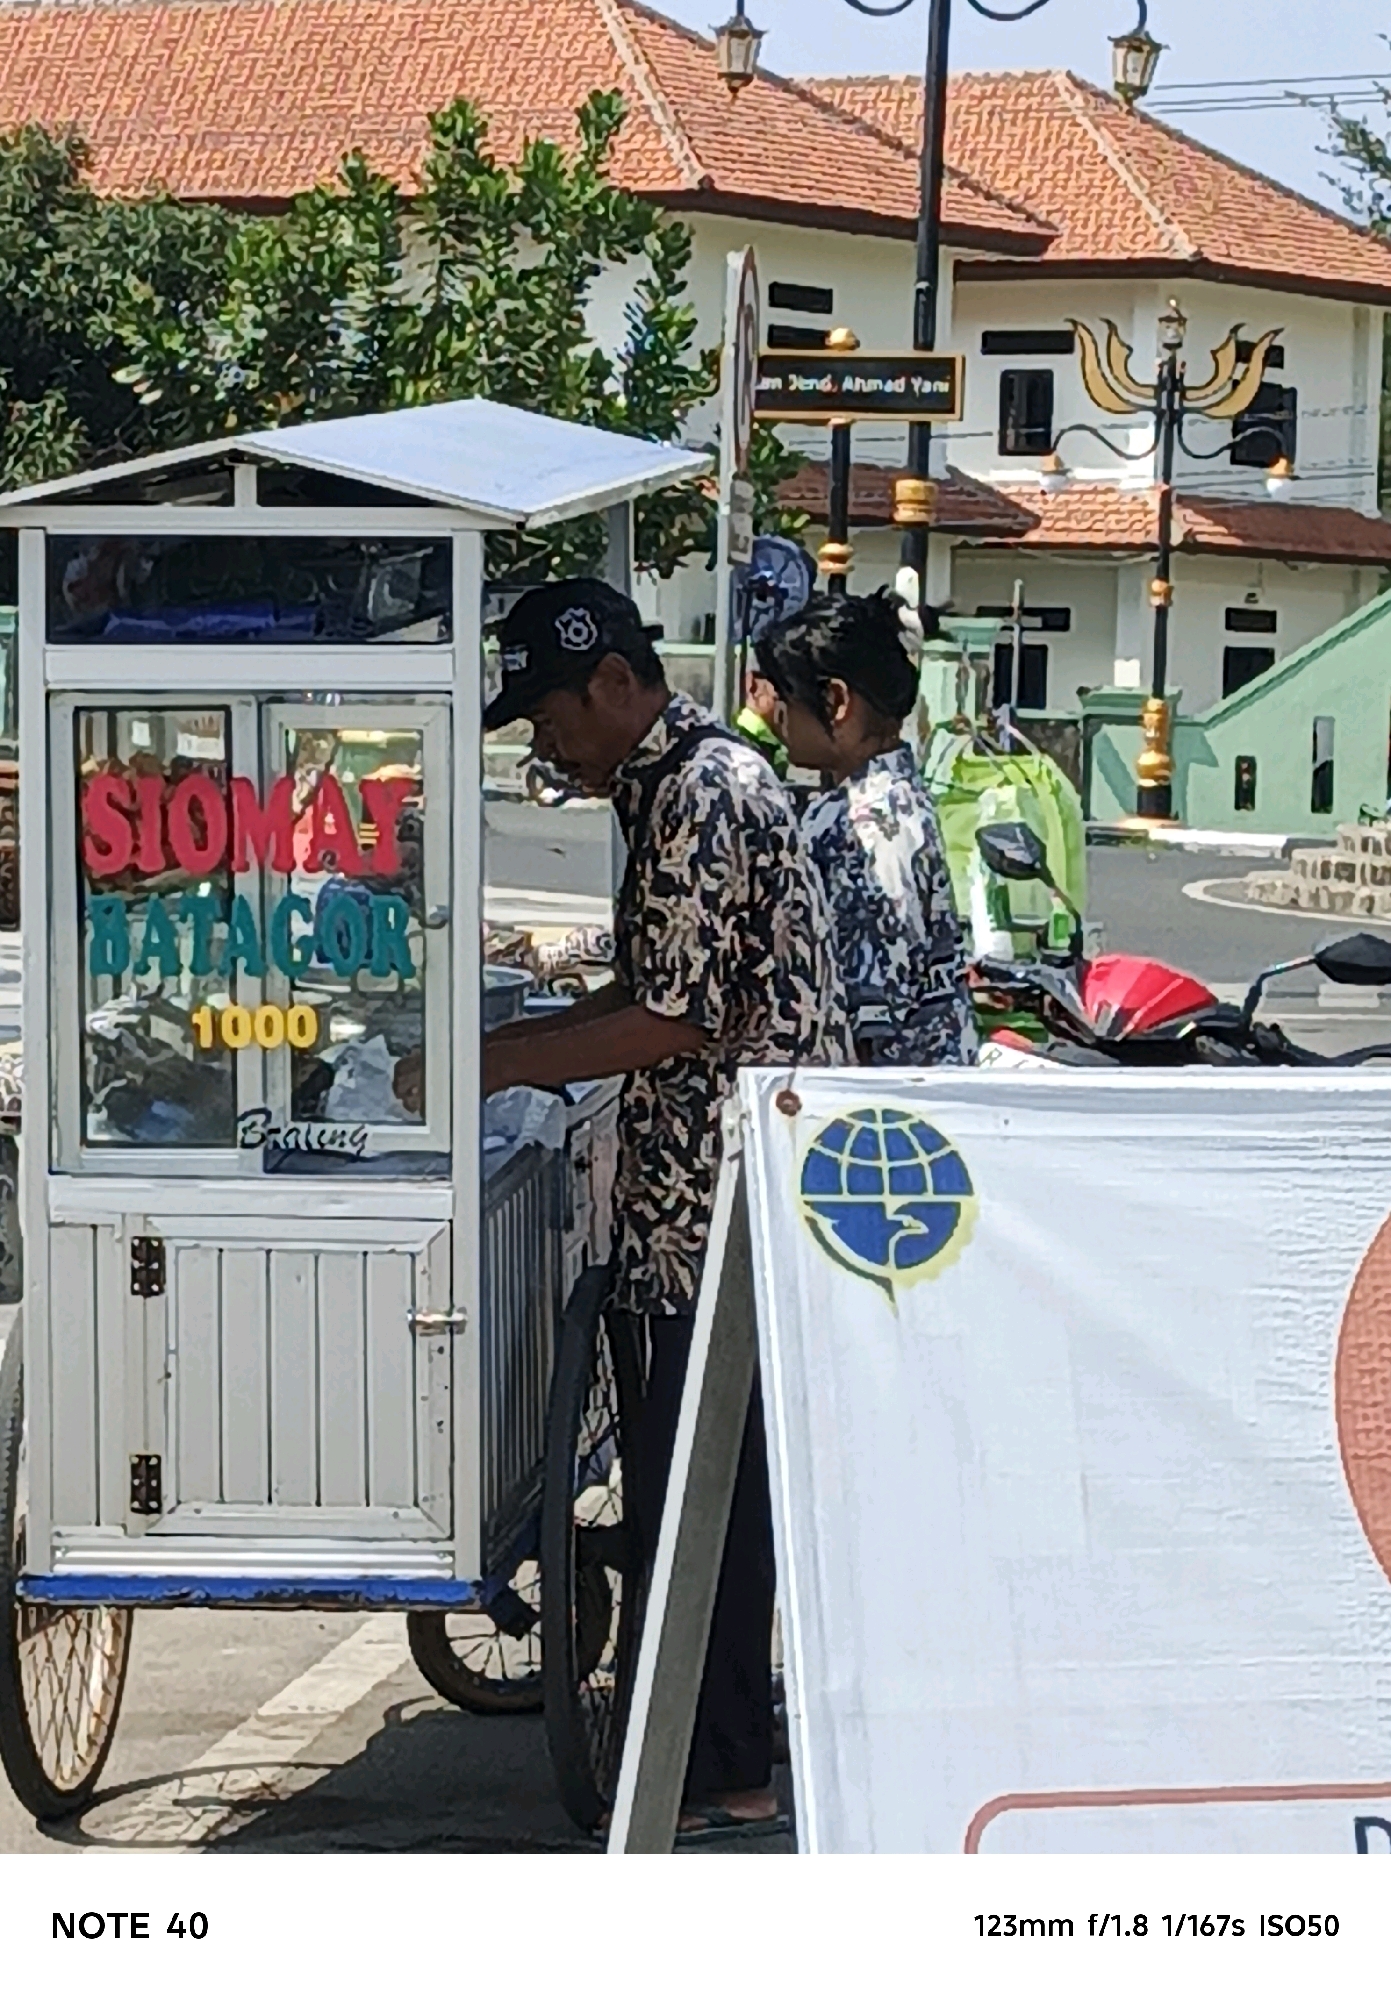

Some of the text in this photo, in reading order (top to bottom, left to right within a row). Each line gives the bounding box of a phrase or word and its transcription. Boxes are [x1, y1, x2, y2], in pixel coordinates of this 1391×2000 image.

[841, 375, 906, 393] Ahmad
[910, 375, 951, 398] Yani
[82, 774, 413, 876] SIOMAY
[90, 894, 416, 979] BATAGOR
[192, 1005, 318, 1048] 1000
